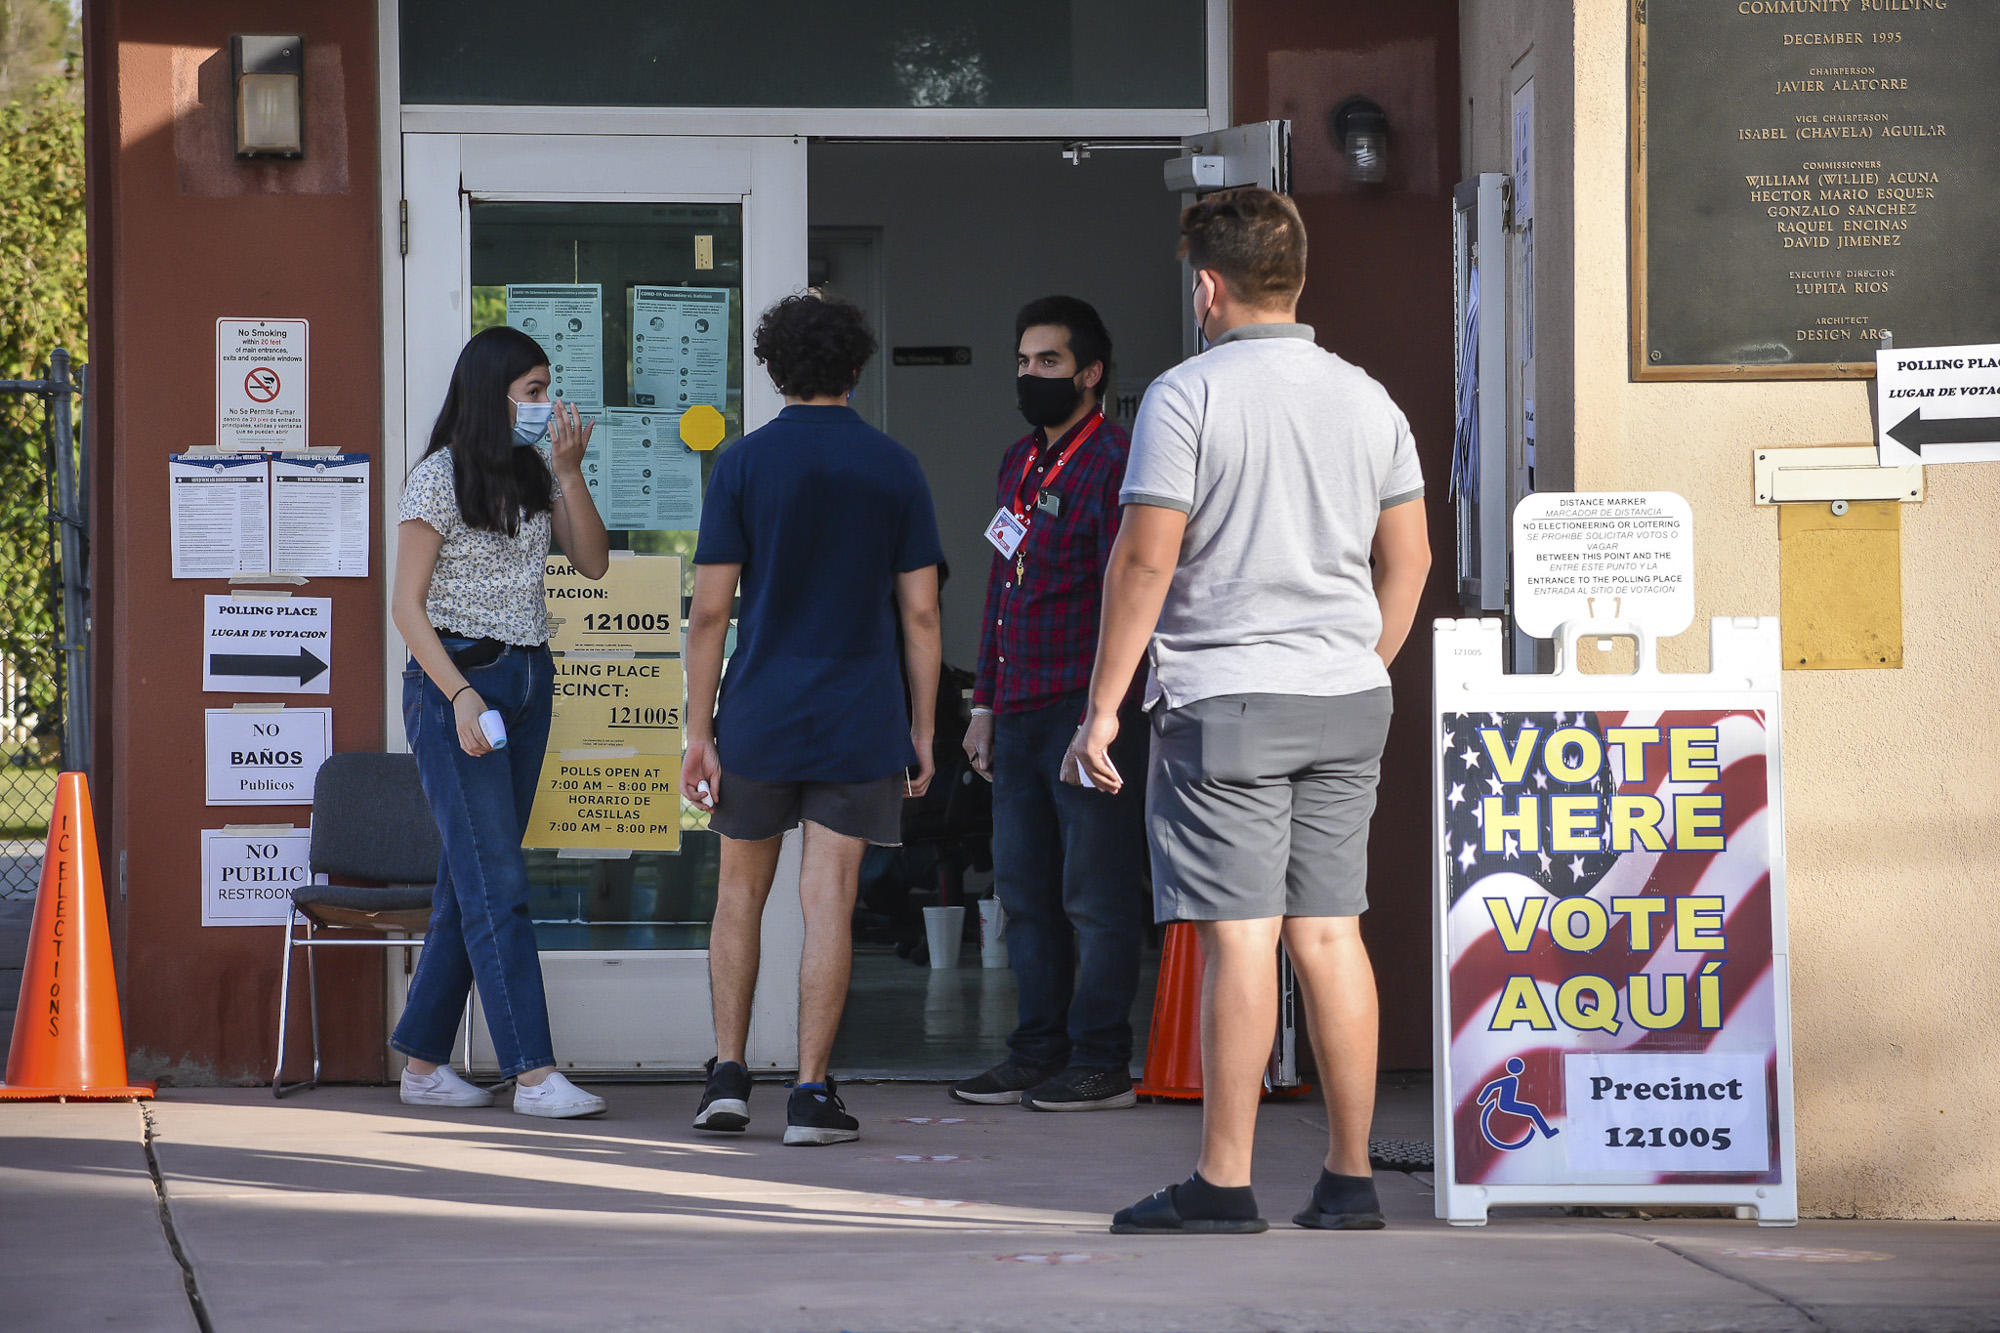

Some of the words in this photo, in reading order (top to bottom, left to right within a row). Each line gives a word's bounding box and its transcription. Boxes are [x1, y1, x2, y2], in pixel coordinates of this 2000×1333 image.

[1738, 1, 1850, 15] COMMUNITY
[1861, 0, 1948, 12] BUILDING
[1783, 33, 1863, 46] DECEMBER
[1872, 32, 1902, 44] 1995
[1809, 67, 1875, 76] CHAIRPERSON
[1775, 81, 1825, 95] JAVIER
[1832, 79, 1908, 92] ALATORRE
[1796, 115, 1818, 123] VICE
[1822, 113, 1889, 123] CHAIRPERSON
[1738, 128, 1788, 141] ISABEL
[1796, 126, 1873, 140] (CHAVELA)
[1881, 125, 1946, 137] AGUILAR
[1803, 161, 1882, 170] COMMISSIONERS
[1745, 175, 1810, 188] WILLIAM
[1818, 173, 1880, 187] (WILLIE)
[1887, 172, 1939, 184] ACUNA
[1751, 190, 1812, 203] HECTOR
[1820, 189, 1869, 201] MARIO
[1877, 187, 1935, 201] ESQUER
[1767, 205, 1840, 218] GONZALO
[1848, 203, 1917, 216] SANCHEZ
[1777, 221, 1834, 235] RAQUEL
[1844, 219, 1908, 232] ENCINAS
[1783, 236, 1830, 249] DAVID
[1837, 234, 1901, 250] JIMENEZ
[1789, 270, 1841, 279] EXECUTIVE
[1846, 269, 1895, 278] DIRECTOR
[1796, 282, 1847, 295] LUPITA
[1855, 281, 1889, 293] RIOS
[1814, 316, 1869, 325] ARCHITECT
[238, 329, 250, 337] No
[251, 328, 287, 339] Smoking
[1796, 329, 1851, 341] DESIGN
[1897, 359, 1965, 371] POLLING
[1967, 358, 2000, 369] PLA
[1888, 388, 1935, 399] LUGAR
[1937, 387, 1957, 397] DE
[1560, 499, 1604, 507] DISTANCE
[1607, 498, 1647, 506] MARKER
[1545, 509, 1598, 518] MARCADOR
[1599, 508, 1612, 517] DE
[1615, 508, 1662, 516] DISTANCIA
[1539, 522, 1615, 530] ELECTIONEERING
[1617, 521, 1631, 529] OR
[1633, 520, 1680, 528] LOITERING
[1527, 533, 1539, 541] SE
[1541, 532, 1583, 541] PROHIBE
[1585, 531, 1634, 540] SOLICITAR
[1636, 531, 1668, 539] VOTOS
[1587, 543, 1619, 551] VAGAR
[1536, 553, 1580, 561] BETWEEN
[1582, 553, 1602, 561] THIS
[1604, 552, 1630, 560] POINT
[1632, 552, 1652, 560] AND
[546, 565, 577, 576] GAR
[1550, 563, 1580, 572] ENTRE
[1581, 563, 1604, 571] ESTE
[1606, 562, 1637, 571] PUNTO
[1639, 562, 1646, 570] Y
[1647, 562, 1658, 570] LA
[1527, 577, 1575, 585] ENTRANCE
[1578, 576, 1590, 584] TO
[1592, 575, 1610, 584] THE
[1612, 575, 1651, 583] POLLING
[1653, 574, 1683, 583] PLACE
[546, 588, 609, 600] TACION:
[1534, 587, 1576, 596] ENTRADA
[1577, 587, 1588, 595] AL
[1590, 586, 1614, 595] SITIO
[1615, 586, 1628, 594] DE
[1630, 585, 1676, 594] VOTACION
[219, 605, 274, 615] POLLING
[276, 607, 318, 617] PLACE
[583, 613, 671, 631] 121005
[211, 629, 249, 638] LUGAR
[251, 630, 267, 638] DE
[270, 630, 328, 639] VOTACION
[1453, 648, 1483, 656] 121005
[555, 664, 601, 677] LING
[606, 665, 661, 678] PLACE
[552, 683, 629, 698] ECINCT:
[609, 706, 680, 725] 121005
[252, 724, 280, 737] NO
[231, 748, 303, 766] BAÑOS
[1475, 726, 1721, 785] VOTE
[560, 766, 601, 777] POLLS
[604, 767, 640, 778] OPEN
[644, 768, 661, 778] AT
[239, 779, 295, 791] Publicos
[550, 780, 579, 790] 7:00
[583, 781, 602, 790] AM
[618, 781, 647, 792] 8:00
[651, 782, 669, 792] PM
[568, 794, 630, 806] HORARIO
[634, 796, 651, 806] DE
[577, 808, 641, 820] CASILLAS
[549, 822, 577, 832] 7:00
[581, 822, 600, 832] AM
[616, 823, 646, 834] 8:00
[649, 824, 668, 834] PM
[1481, 793, 1727, 854] HERE
[246, 844, 279, 860] NO
[221, 866, 304, 883] PUBLIC
[1482, 895, 1728, 953] VOTE
[48, 861, 68, 1037] ELECTIONS
[1488, 959, 1730, 1037] AQUÍ
[1589, 1076, 1743, 1101] Precinct
[1604, 1127, 1732, 1151] 121005
